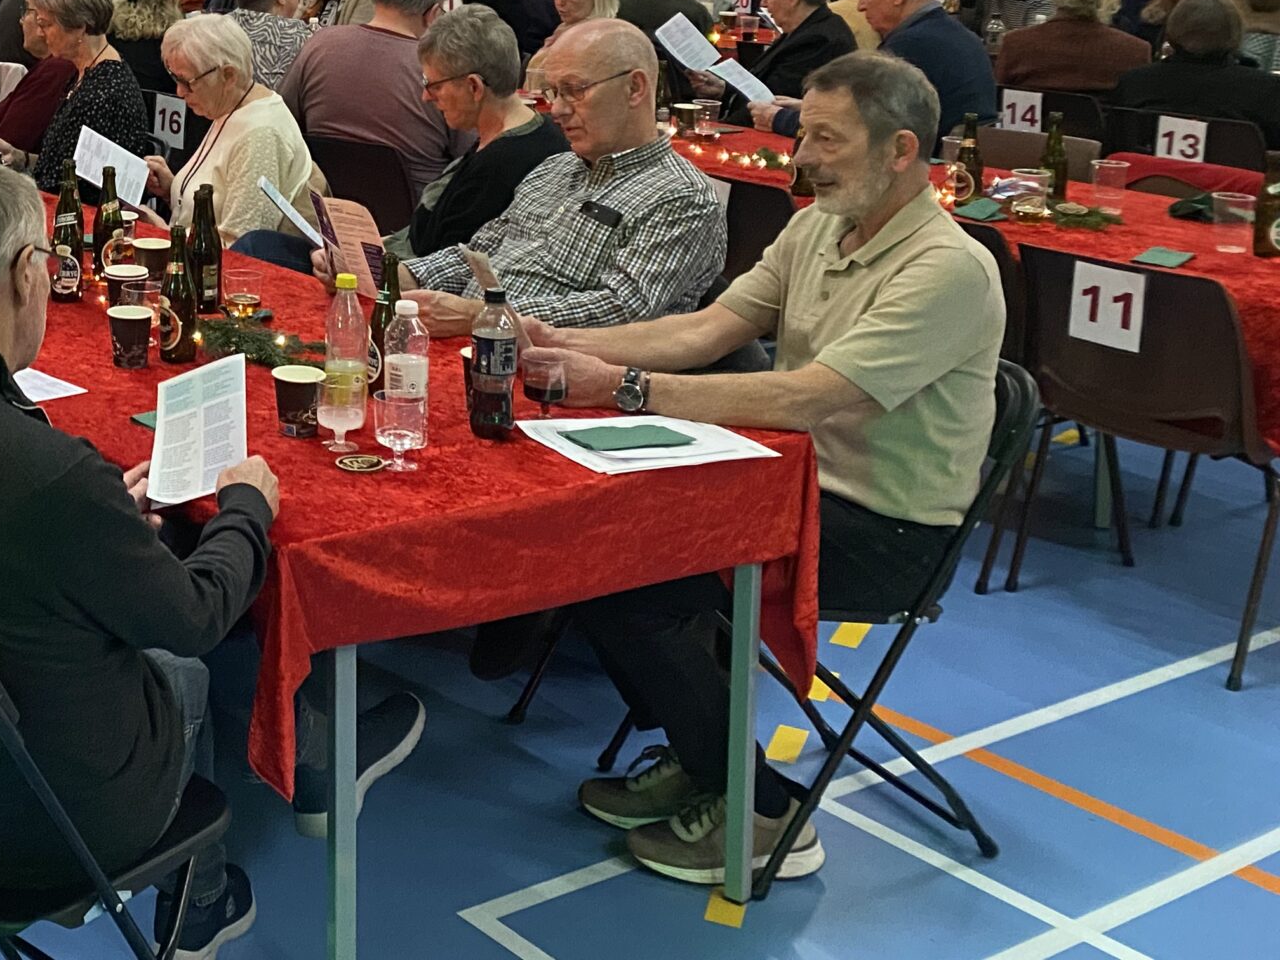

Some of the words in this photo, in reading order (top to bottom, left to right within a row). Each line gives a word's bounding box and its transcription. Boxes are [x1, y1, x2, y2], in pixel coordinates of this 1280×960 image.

[158, 108, 182, 134] 16
[1006, 102, 1039, 127] 14
[1161, 130, 1200, 159] 13
[1082, 285, 1133, 330] 11
